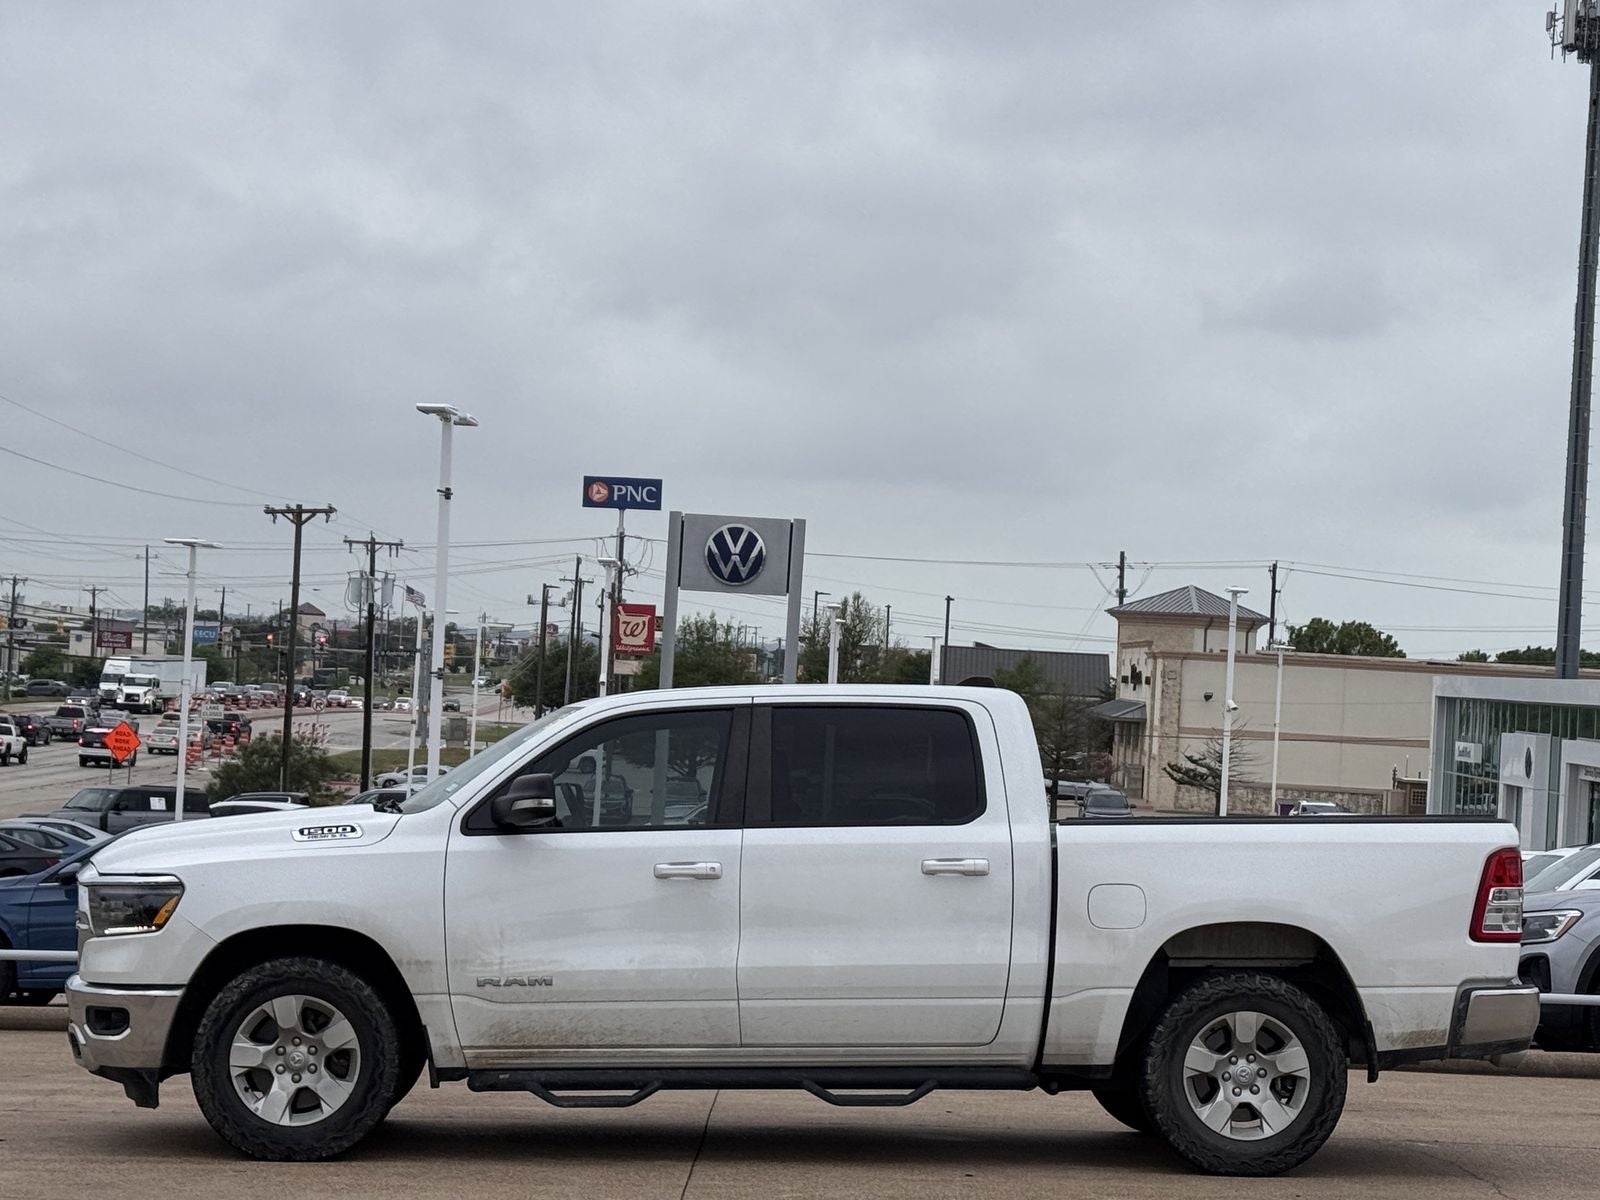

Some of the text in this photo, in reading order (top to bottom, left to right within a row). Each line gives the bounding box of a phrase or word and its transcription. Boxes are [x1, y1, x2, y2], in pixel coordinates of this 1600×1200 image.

[612, 485, 657, 503] PNC
[115, 730, 131, 738] ROAD
[303, 826, 352, 835] 1500
[476, 976, 553, 987] RAM
